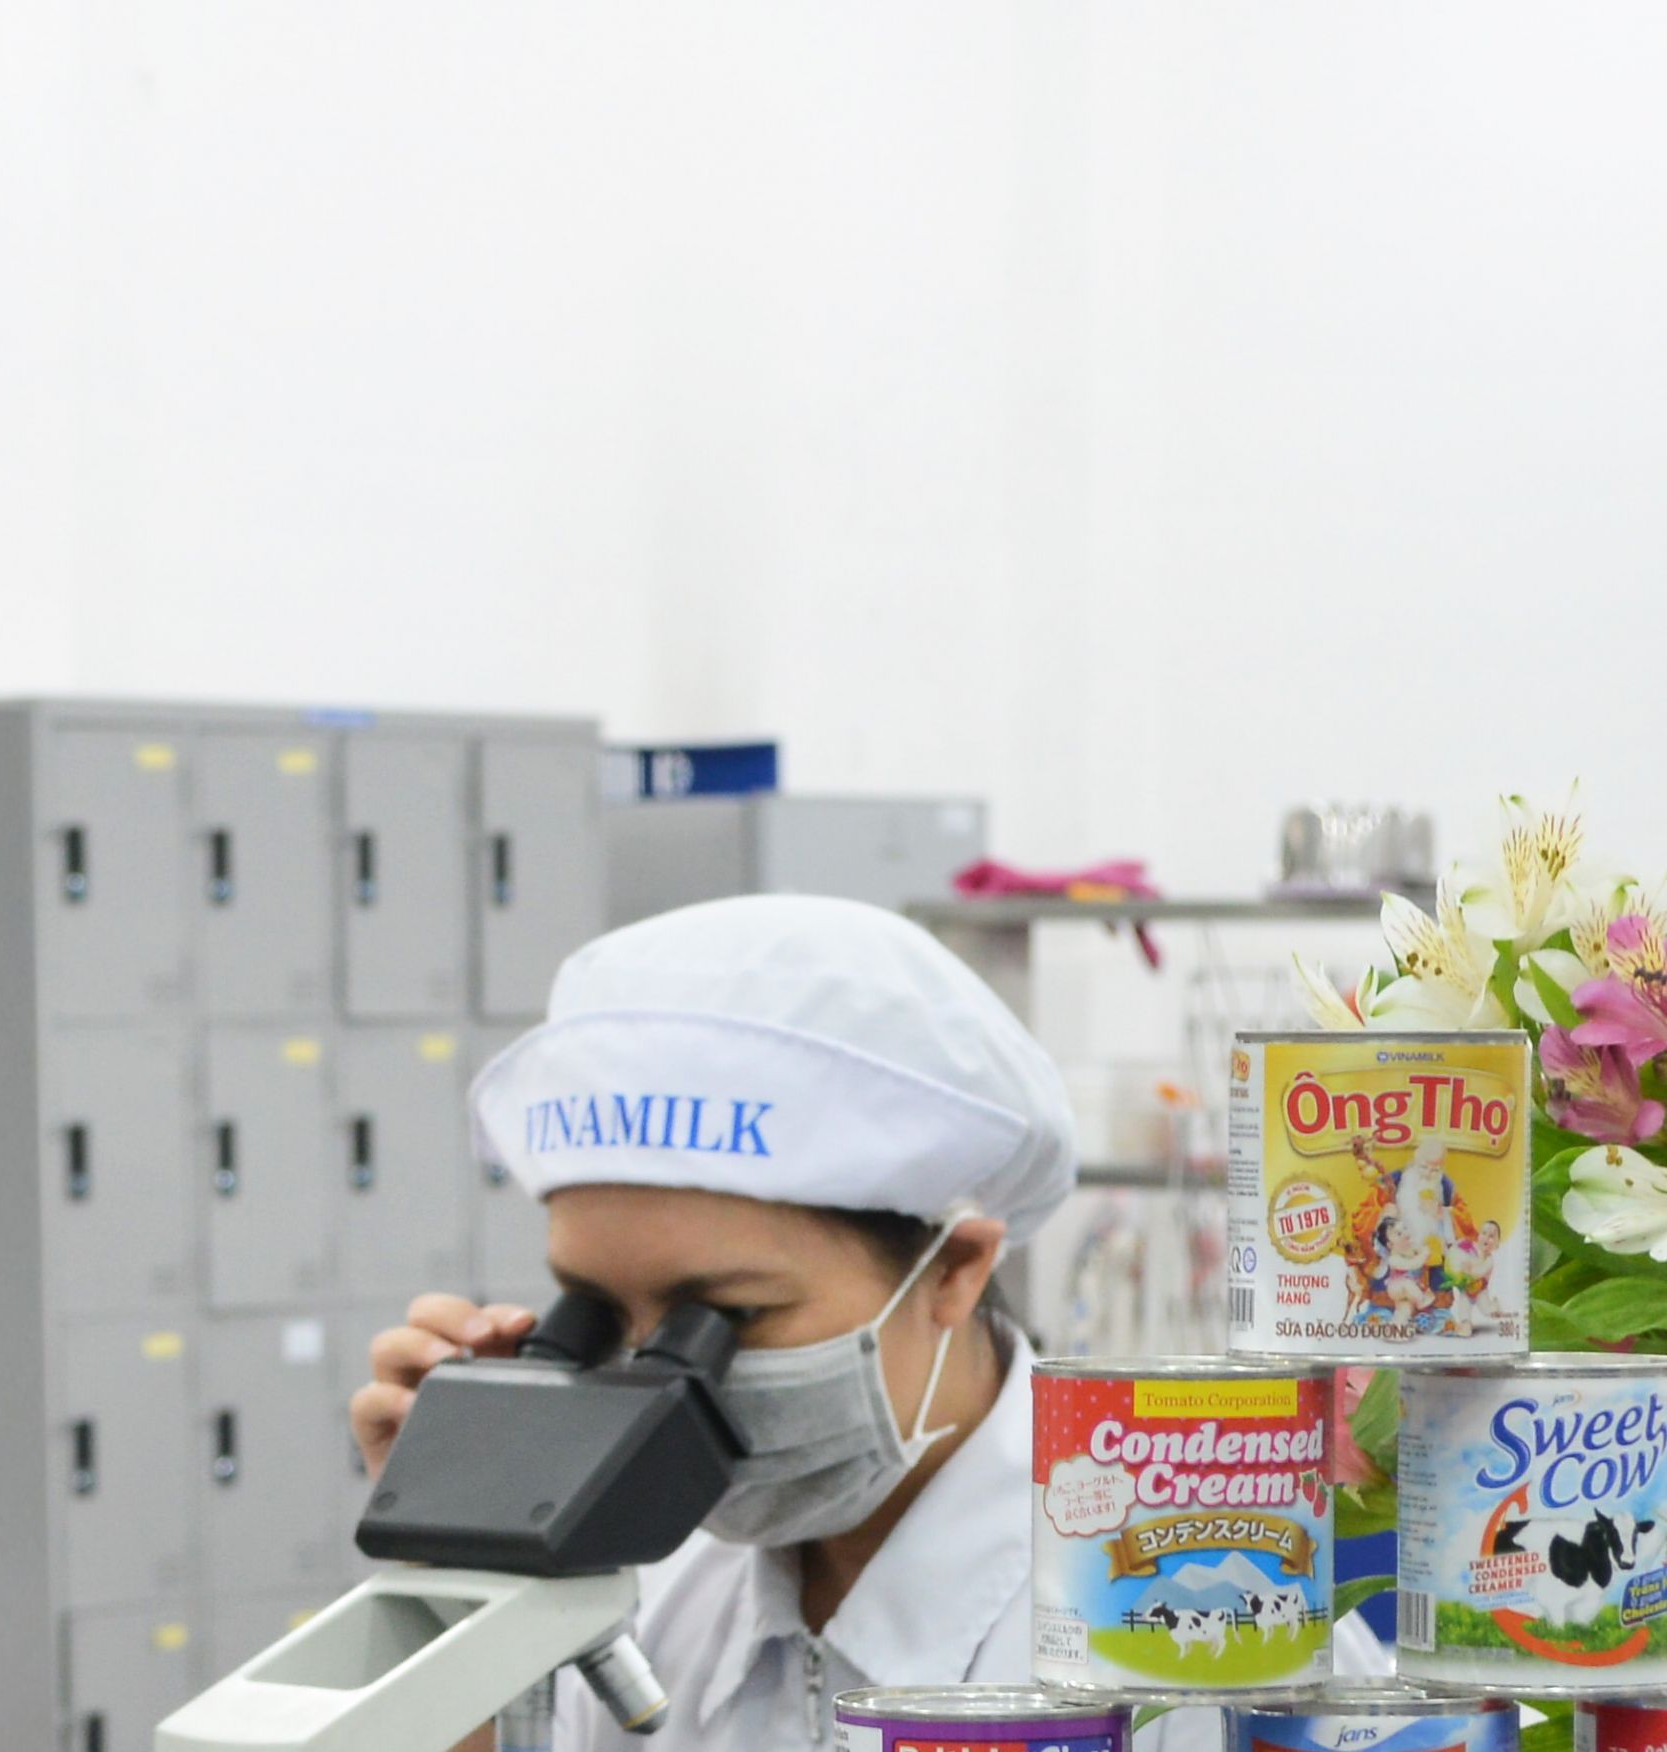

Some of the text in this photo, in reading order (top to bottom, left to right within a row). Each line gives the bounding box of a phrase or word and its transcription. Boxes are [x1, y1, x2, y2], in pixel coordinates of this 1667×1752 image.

[1390, 1051, 1445, 1063] VINAMILK
[1286, 1071, 1510, 1147] Ông Thọ
[524, 1092, 778, 1159] VINAMILK
[1298, 1206, 1330, 1230] 1976
[1144, 1393, 1292, 1410] Tomato Corporation
[1090, 1418, 1324, 1465] Condensed
[1475, 1393, 1667, 1489] Sweet
[1136, 1463, 1295, 1508] Cream
[1137, 1518, 1294, 1552] コンデンスクリーム
[1469, 1552, 1539, 1571] SWEETENED
[1475, 1563, 1547, 1581] CONDENSED
[1468, 1579, 1523, 1594] CREAMER
[1334, 1724, 1378, 1748] jans
